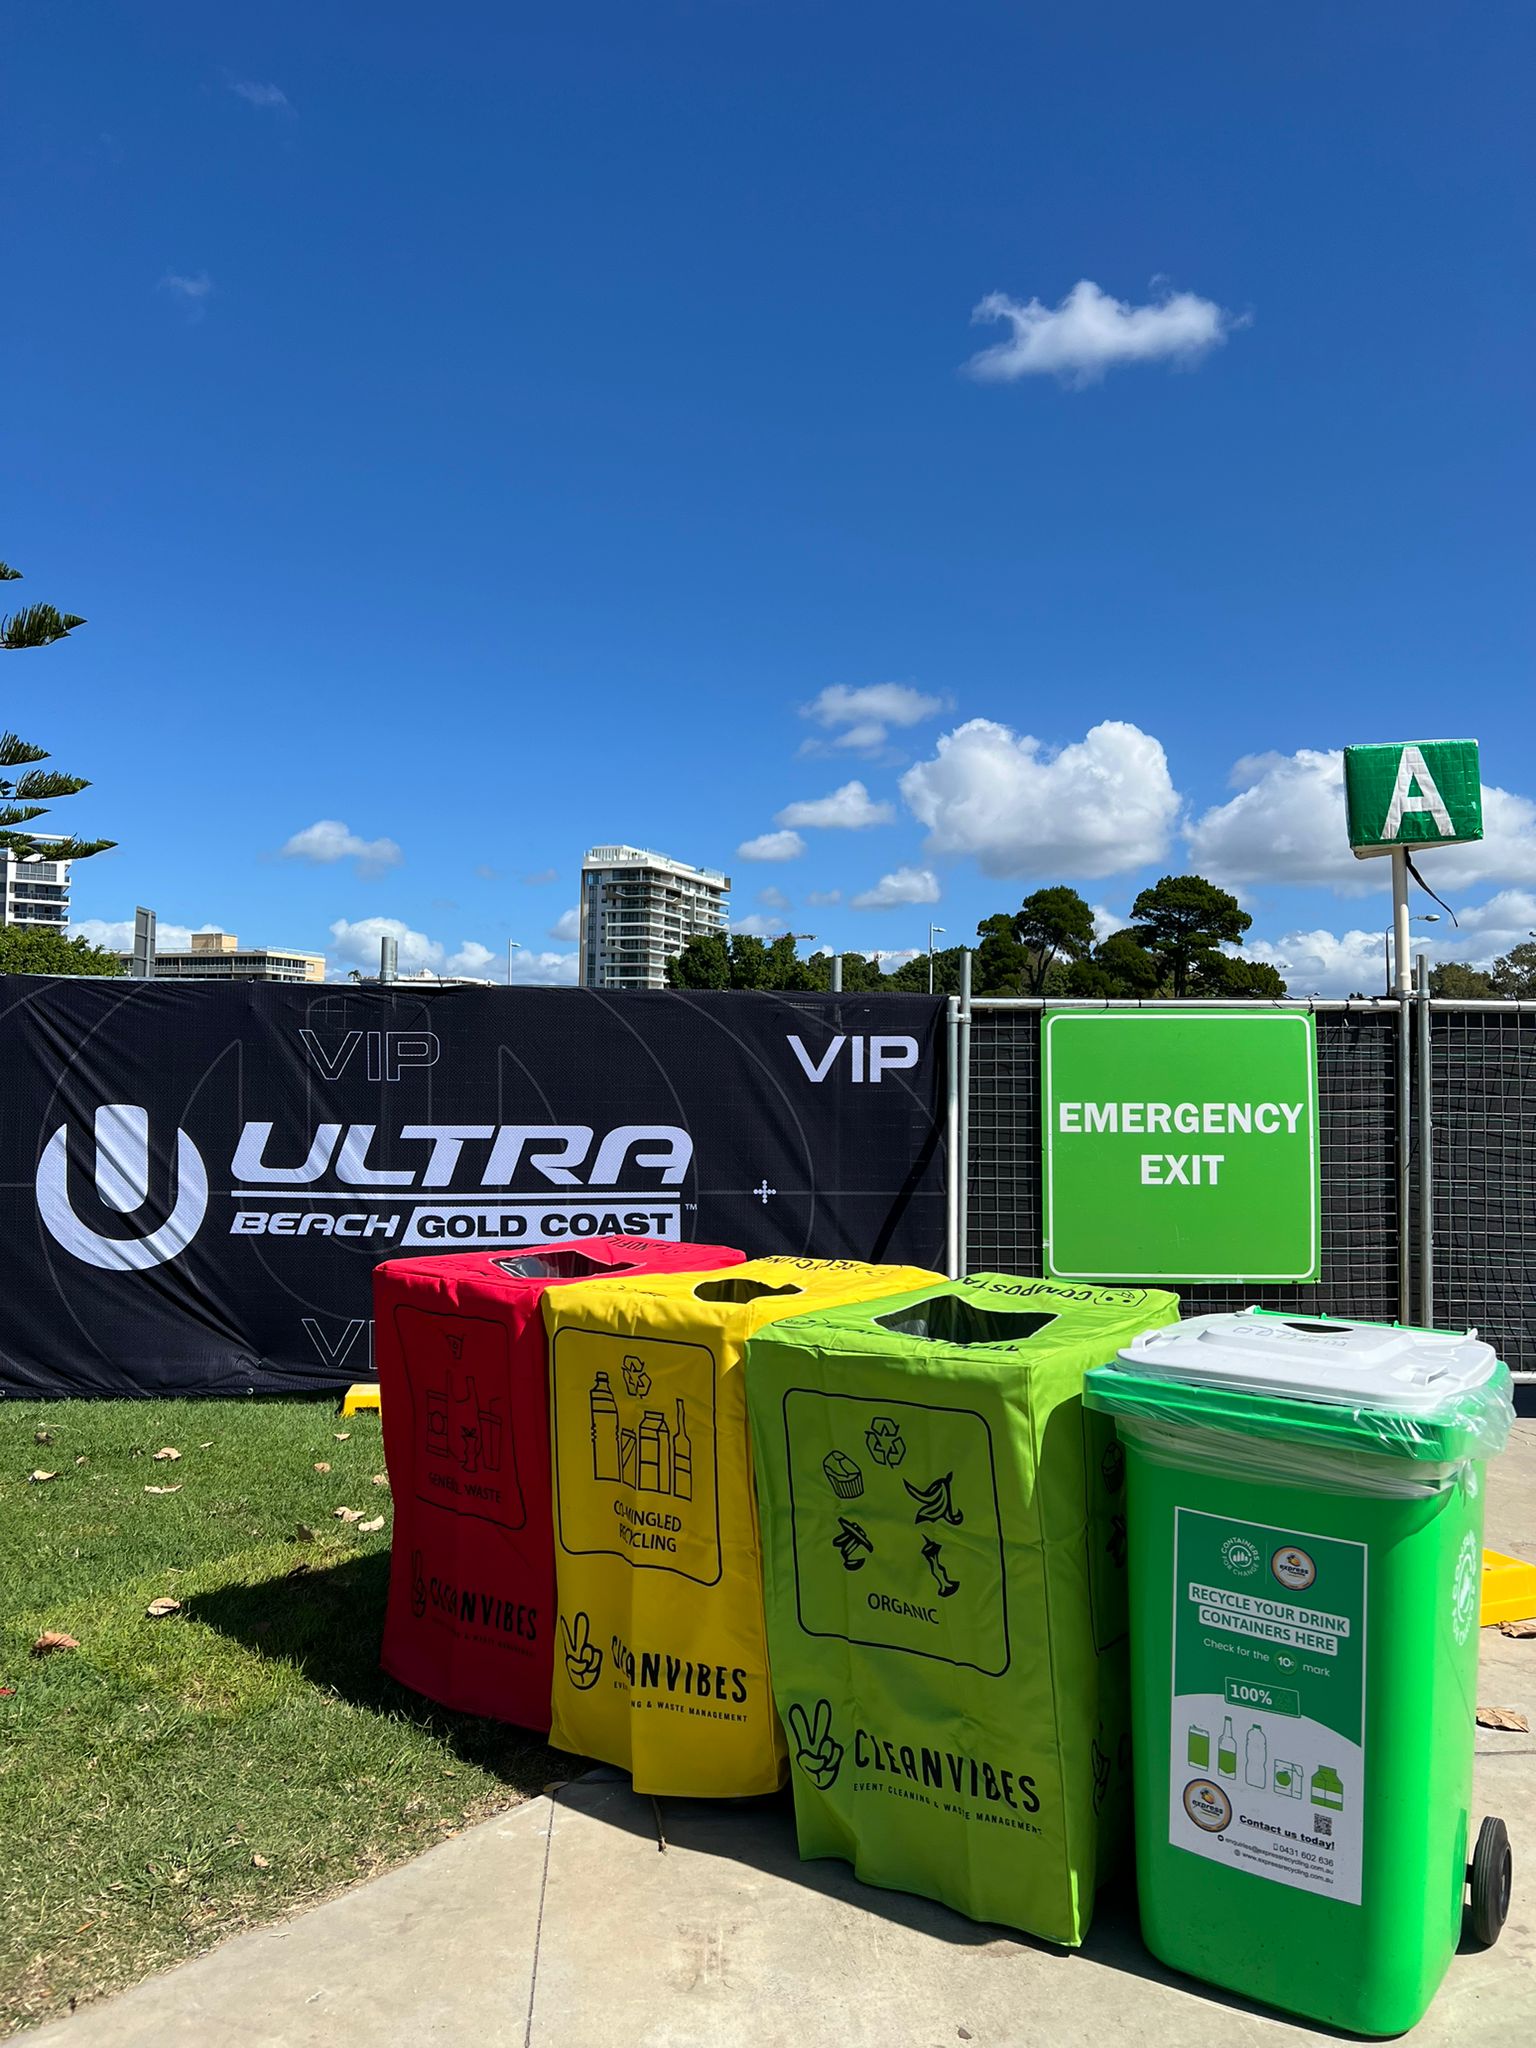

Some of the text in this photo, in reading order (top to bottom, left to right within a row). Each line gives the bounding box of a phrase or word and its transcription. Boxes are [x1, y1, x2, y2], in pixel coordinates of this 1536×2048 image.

[1380, 746, 1456, 839] A
[299, 1029, 440, 1081] VIP
[786, 1035, 919, 1083] VIP
[1058, 1102, 1304, 1134] EMERGENCY
[231, 1122, 694, 1187] ULTRA
[1140, 1154, 1225, 1185] EXIT
[229, 1212, 674, 1239] BEACH GOLD COAST
[1221, 1536, 1260, 1561] CONTAINERS
[867, 1592, 940, 1625] ORGANIC
[1192, 1586, 1347, 1633] RECYCLE YOUR DRINK
[1201, 1609, 1335, 1651] CONTAINERS HERE
[1203, 1638, 1235, 1653] Check
[1236, 1645, 1250, 1657] for
[1253, 1651, 1270, 1662] the
[1302, 1663, 1331, 1677] mark
[657, 1701, 685, 1713] WASTE
[688, 1707, 748, 1723] MANAGEMENT
[1230, 1684, 1273, 1705] 100%
[854, 1728, 1041, 1813] CLEANVIBES
[853, 1782, 884, 1792] EVENT
[888, 1786, 931, 1804] CLEANING
[976, 1812, 1042, 1835] MANAGEMENT
[1239, 1814, 1282, 1835] Contact
[1284, 1829, 1297, 1840] us
[1300, 1833, 1335, 1850] today!
[1279, 1845, 1334, 1867] 0431 602 636
